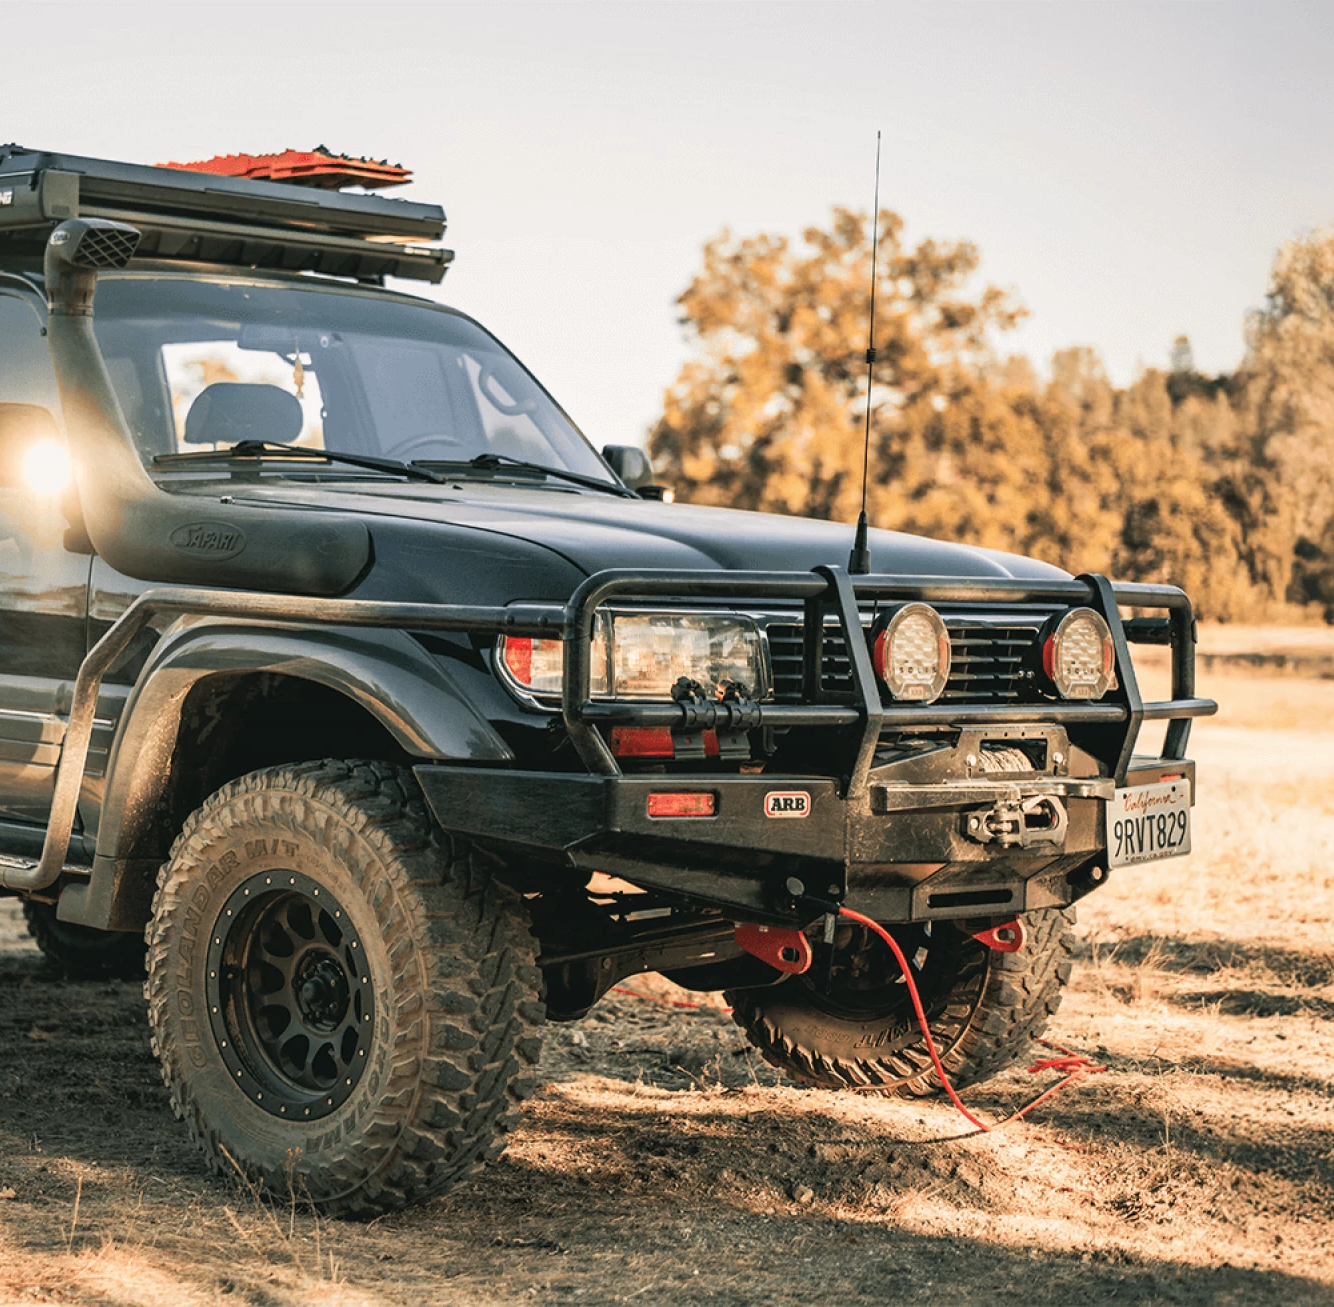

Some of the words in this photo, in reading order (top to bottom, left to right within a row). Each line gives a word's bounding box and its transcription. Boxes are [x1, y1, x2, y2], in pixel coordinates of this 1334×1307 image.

[770, 797, 805, 812] ARB
[1124, 791, 1176, 814] California
[1114, 810, 1187, 858] 9RVT829
[177, 850, 241, 1068] GEOLANDAR
[244, 838, 299, 859] M/T
